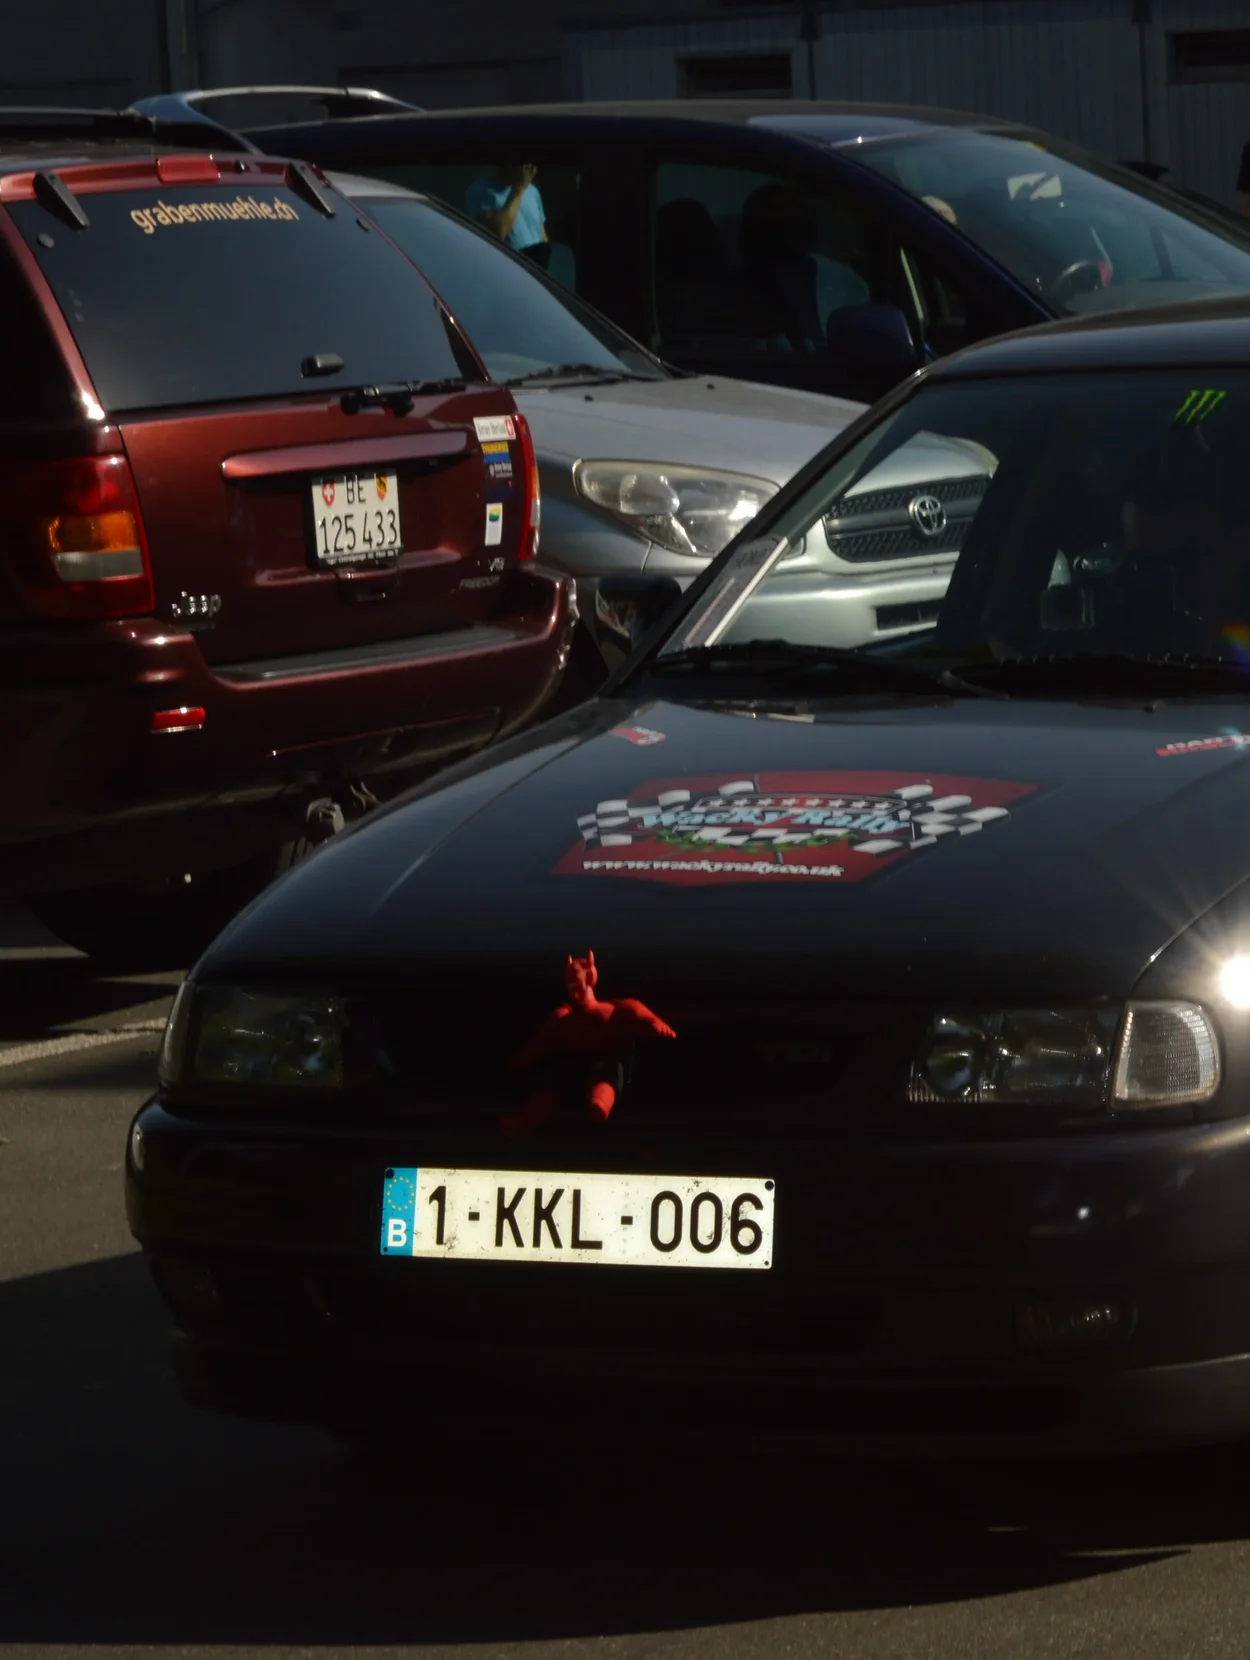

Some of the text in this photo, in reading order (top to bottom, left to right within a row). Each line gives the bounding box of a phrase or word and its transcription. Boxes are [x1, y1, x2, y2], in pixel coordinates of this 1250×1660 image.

[130, 195, 300, 235] grabenmuehle.ch
[346, 474, 367, 504] BE
[386, 1218, 408, 1248] B
